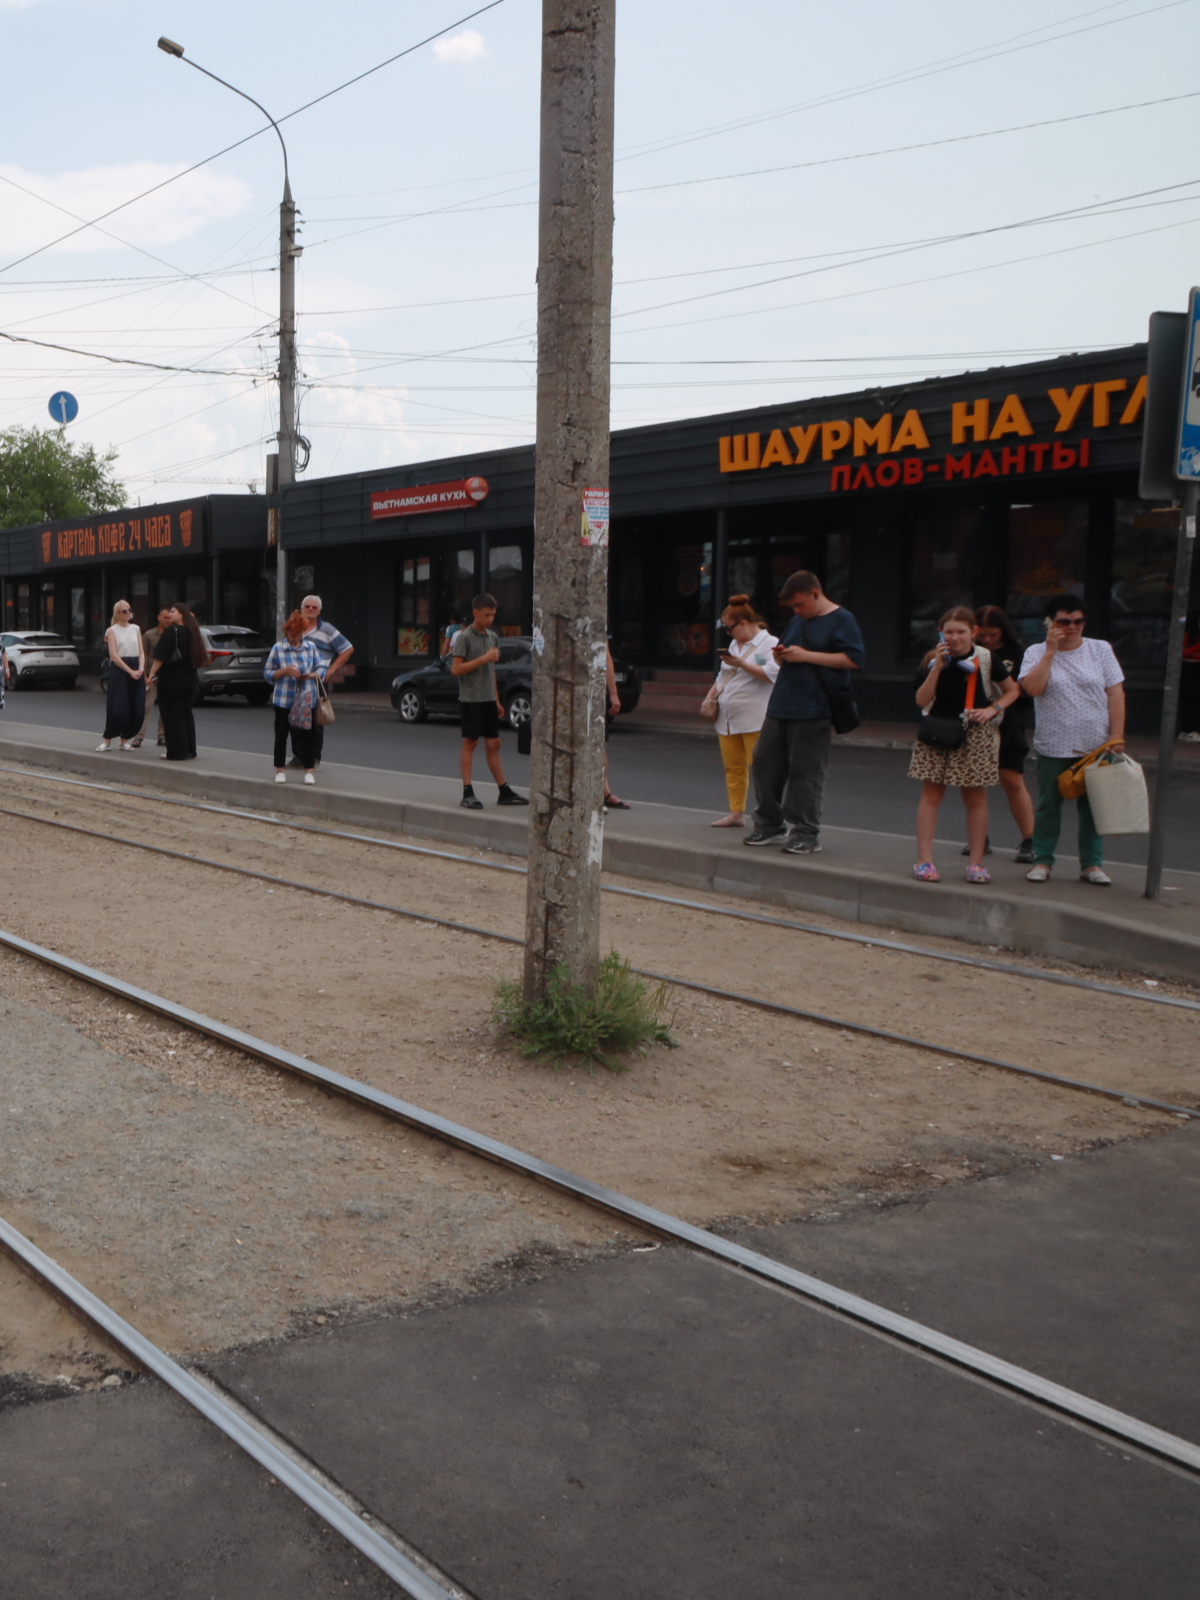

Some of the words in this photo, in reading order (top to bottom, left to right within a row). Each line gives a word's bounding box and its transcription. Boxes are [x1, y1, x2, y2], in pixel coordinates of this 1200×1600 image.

[718, 408, 930, 473] ШАУРМА
[951, 394, 1035, 444] НА
[829, 438, 1091, 492] ПЛОВ-МАНТЫ
[373, 493, 438, 511] ВЬЕТНАМСКАЯ
[440, 490, 467, 502] КУХН
[128, 519, 142, 551] 24
